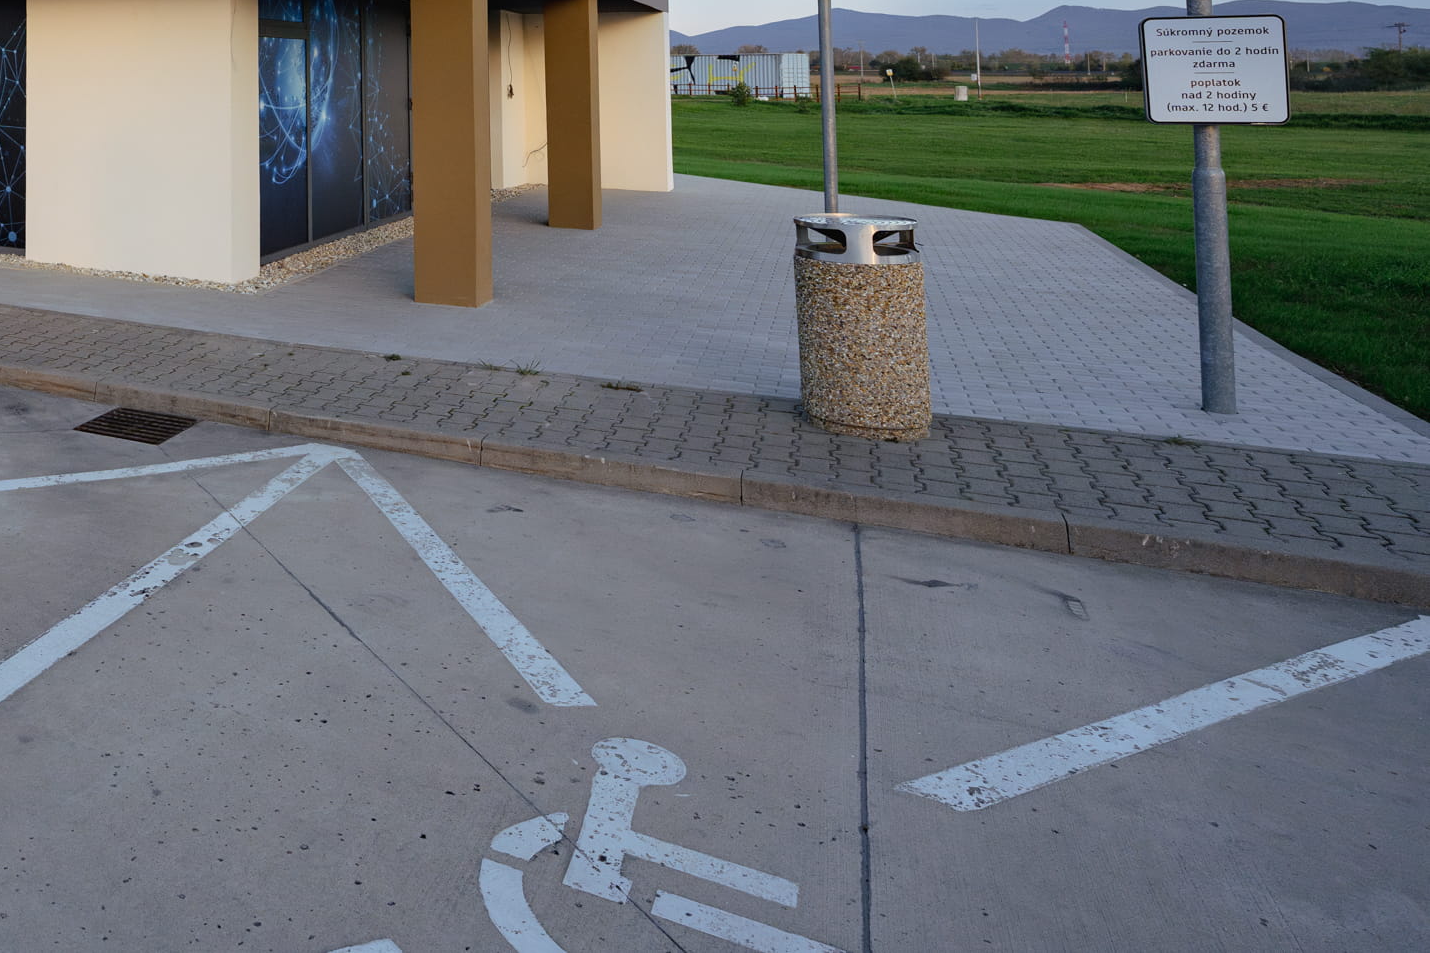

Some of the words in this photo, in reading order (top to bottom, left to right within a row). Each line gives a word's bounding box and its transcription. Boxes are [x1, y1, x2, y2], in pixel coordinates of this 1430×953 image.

[1156, 27, 1213, 37] Súkromný
[1217, 26, 1270, 37] pozemok
[1150, 47, 1213, 57] parkovanie
[1216, 47, 1231, 56] do
[1235, 47, 1242, 55] 2
[1193, 60, 1236, 68] zdarma
[1190, 79, 1241, 88] poplatok
[1181, 91, 1202, 99] nad
[1206, 91, 1213, 99] 2
[1216, 91, 1257, 100] hodiny
[1167, 103, 1199, 113] (max.
[1218, 103, 1248, 112] hod.)
[1251, 103, 1258, 111] 5
